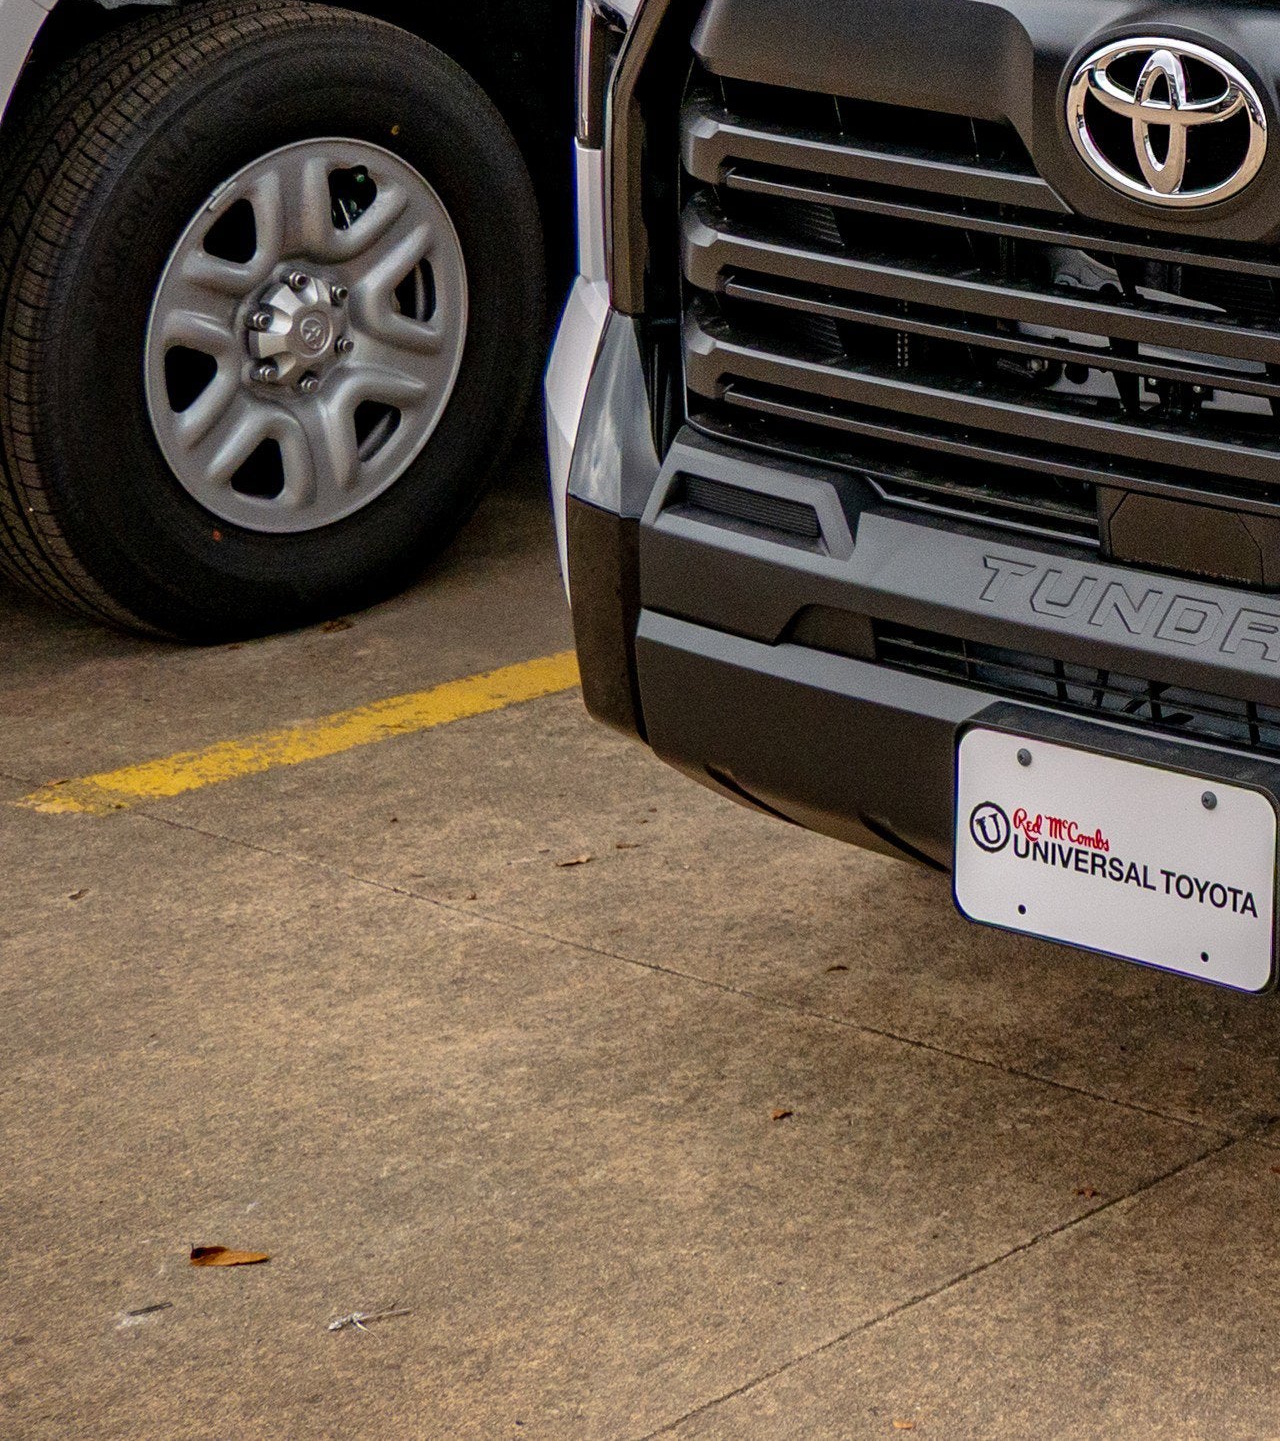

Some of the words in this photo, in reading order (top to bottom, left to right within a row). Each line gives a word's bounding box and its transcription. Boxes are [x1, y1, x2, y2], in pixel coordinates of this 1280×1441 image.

[1013, 808, 1042, 842] Red
[1044, 814, 1110, 852] McCombs
[1013, 833, 1157, 892] UNIVERSAL
[1160, 868, 1259, 919] TOYOTA
